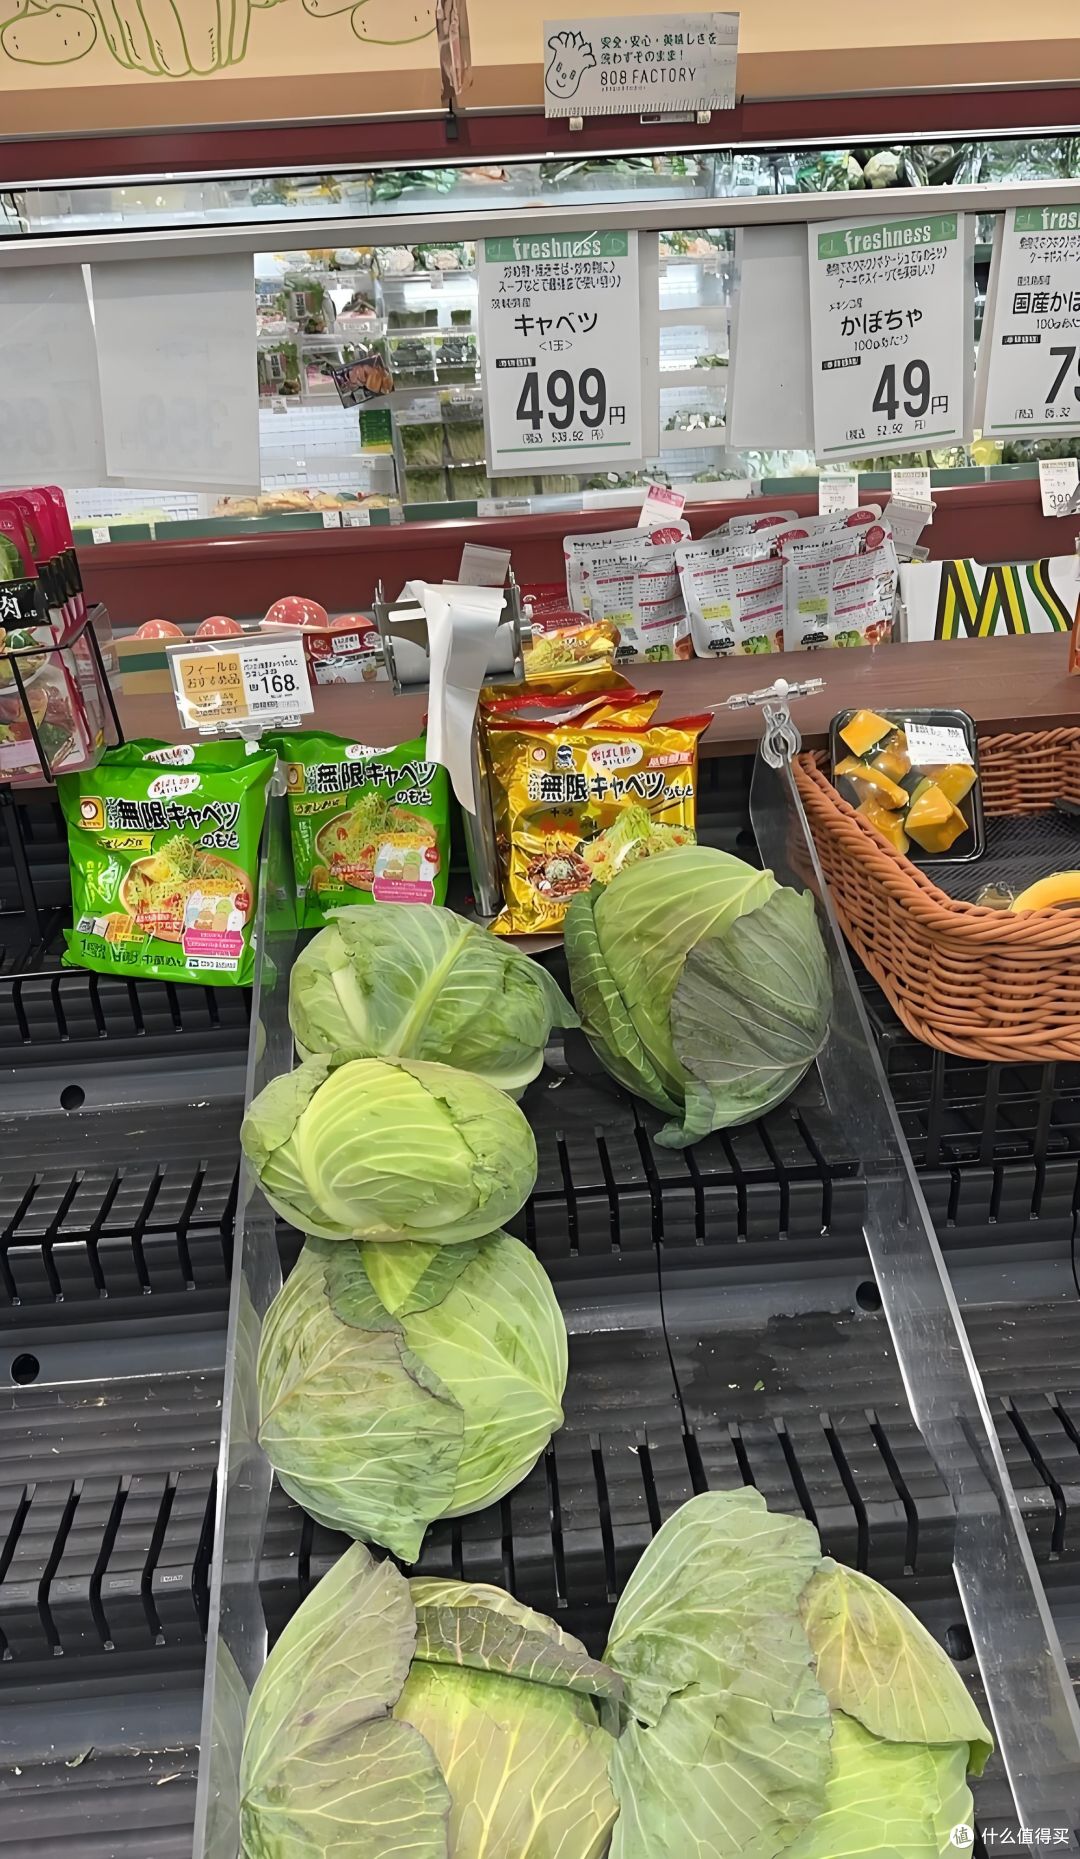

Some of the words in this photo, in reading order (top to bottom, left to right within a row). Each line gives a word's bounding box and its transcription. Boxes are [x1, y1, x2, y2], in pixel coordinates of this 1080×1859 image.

[600, 70, 627, 86] 808
[632, 67, 697, 84] FACTORY
[1041, 207, 1080, 230] fres
[512, 237, 601, 260] freshness
[844, 224, 931, 254] freshness
[513, 312, 599, 337] キャベツ
[840, 308, 923, 337] かぼちゃ
[872, 359, 931, 421] 49
[931, 395, 949, 415] 円
[1045, 346, 1080, 405] 7
[516, 367, 607, 431] 499
[609, 405, 626, 426] 円
[260, 674, 296, 694] 168
[316, 761, 438, 793] 無限キャベツ
[540, 771, 665, 803] 無限キャベツ
[395, 789, 432, 805] のもと
[116, 798, 240, 829] 無限キャベツ
[200, 831, 239, 849] のもと
